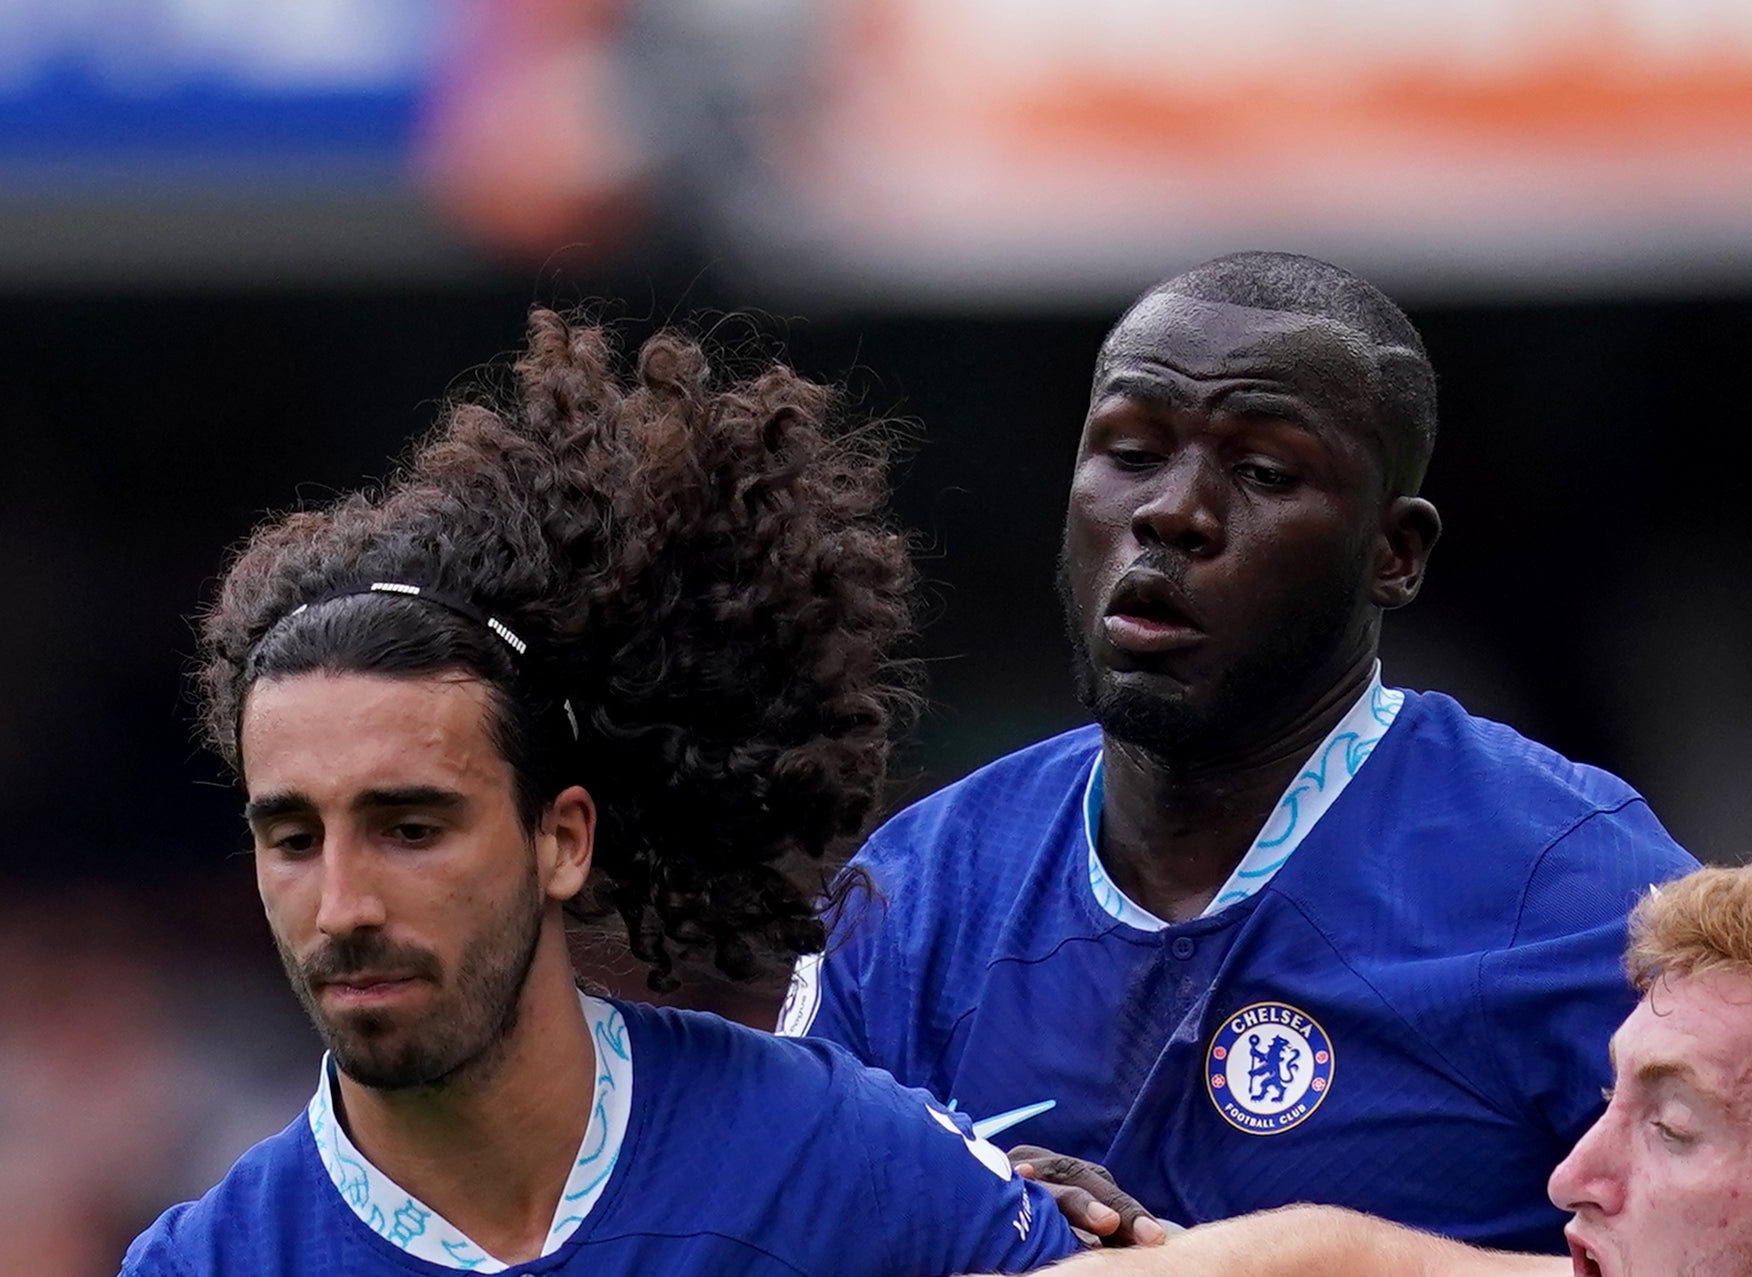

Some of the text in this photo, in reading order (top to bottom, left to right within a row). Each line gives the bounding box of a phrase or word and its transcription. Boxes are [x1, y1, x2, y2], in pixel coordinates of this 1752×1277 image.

[1231, 1007, 1313, 1039] CHELSEA
[1224, 1102, 1307, 1128] FOOTBALL CLUB
